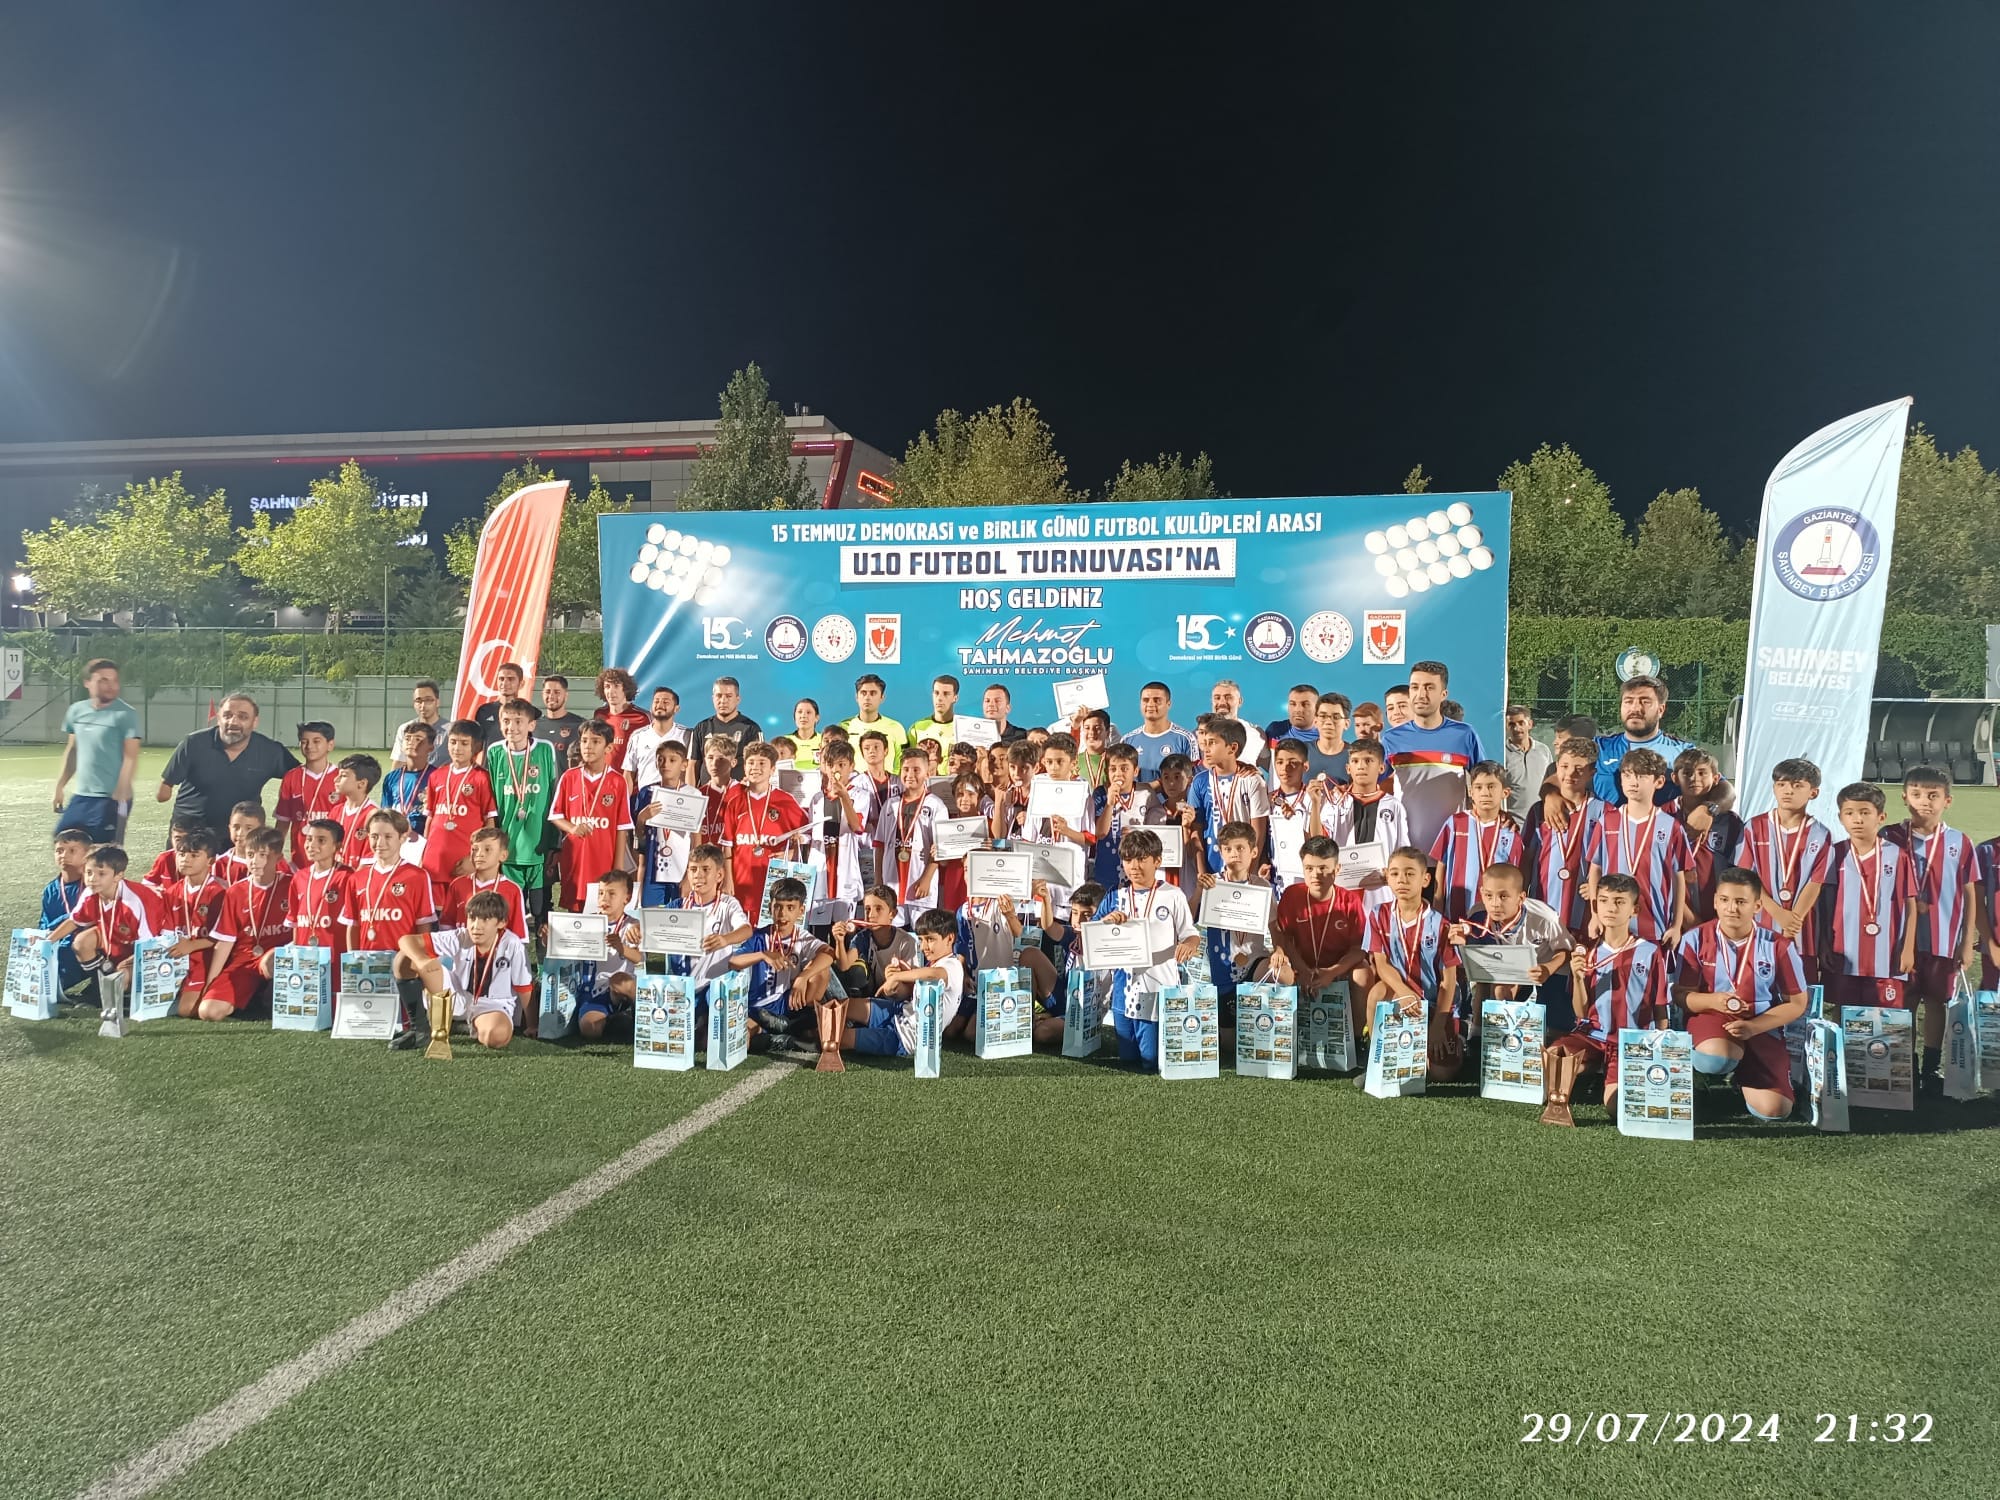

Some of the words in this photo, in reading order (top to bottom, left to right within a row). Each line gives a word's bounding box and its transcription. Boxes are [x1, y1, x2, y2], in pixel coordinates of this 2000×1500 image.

[771, 524, 788, 543] 15
[792, 523, 857, 543] TEMMUZ
[860, 521, 954, 542] DEMOKRASİ
[958, 523, 979, 540] ve
[983, 519, 1038, 540] BİRLİK
[1042, 515, 1090, 538] GÜNÜ
[1094, 515, 1160, 537] FUTBOL
[1164, 510, 1261, 535] KULÜPLERİ
[1265, 511, 1322, 533] ARASI
[1803, 510, 1858, 525] GAZİANTEP
[853, 552, 901, 576] U10
[909, 550, 1007, 576] FUTBOL
[1017, 547, 1221, 575] TURNUVASI'NA
[1820, 553, 1875, 598] BELEDİYESİ
[959, 588, 1003, 612] HOŞ
[1007, 587, 1104, 609] GELDİNİZ
[975, 615, 1102, 649] Mehmet
[957, 646, 1114, 665] TAHMAZOĞLU
[962, 667, 1010, 676] ŞAHİNBEY
[1014, 666, 1062, 675] BELEDİYE
[1065, 666, 1109, 675] BAŞKANI
